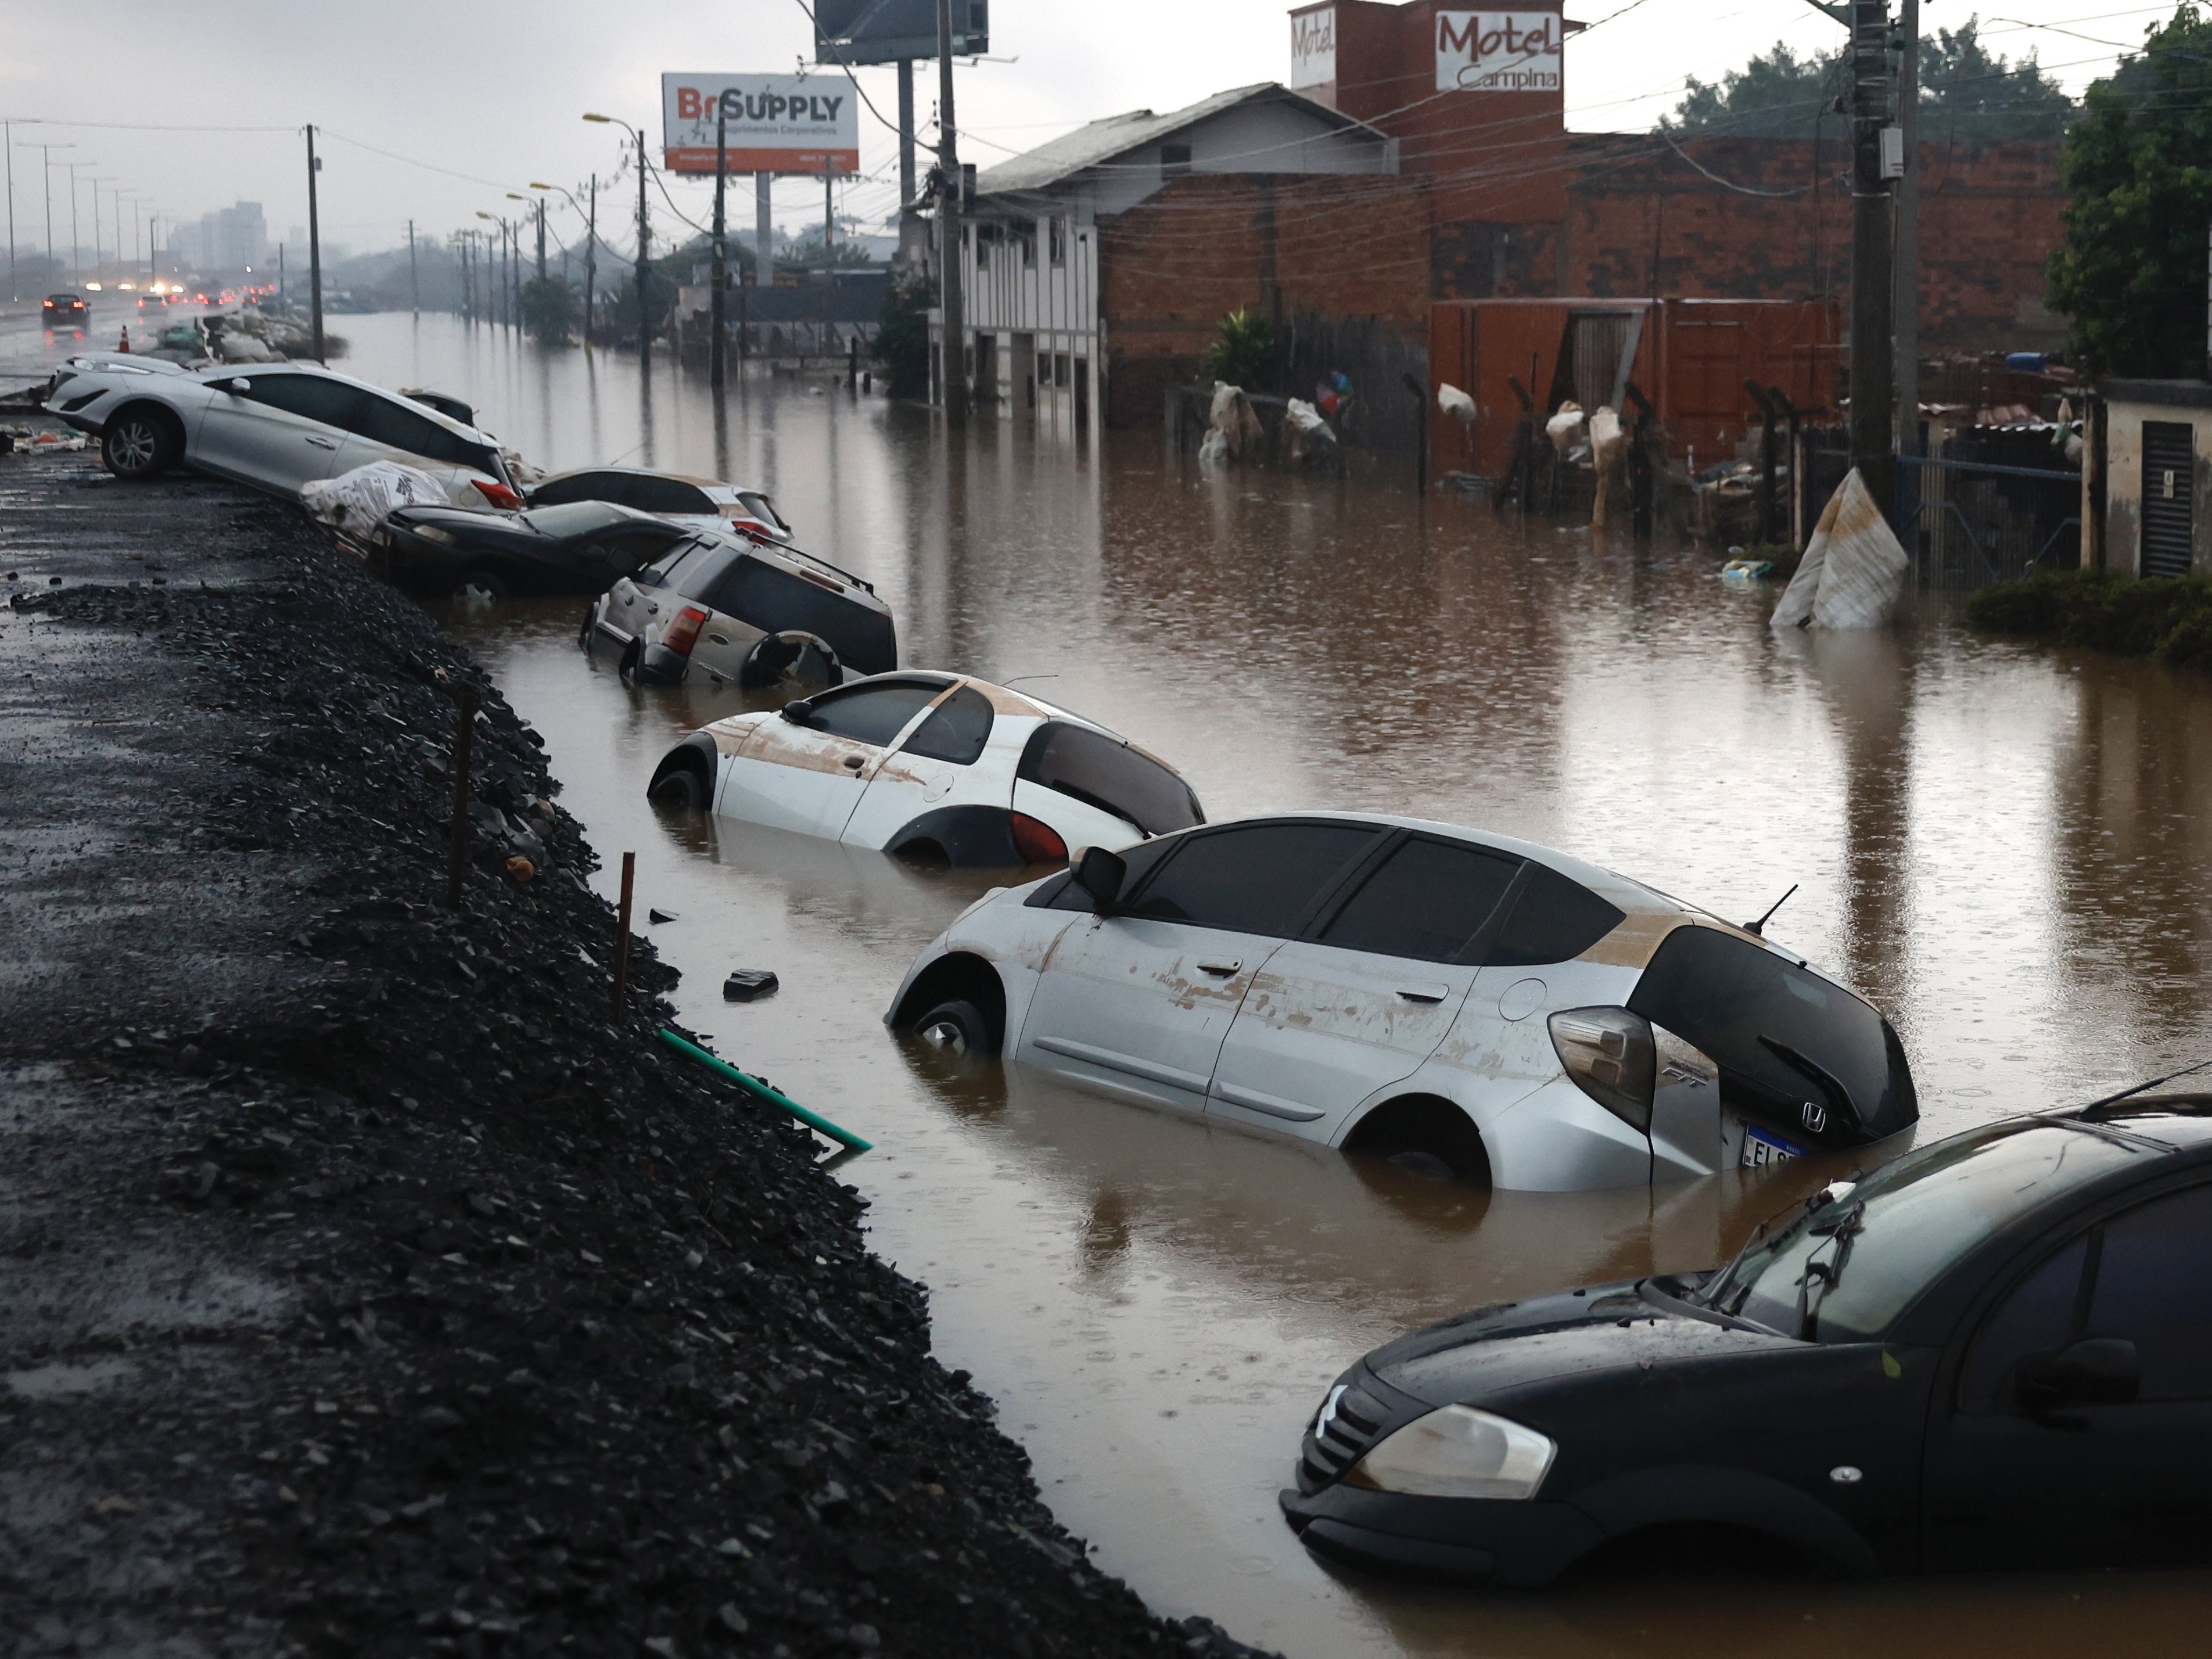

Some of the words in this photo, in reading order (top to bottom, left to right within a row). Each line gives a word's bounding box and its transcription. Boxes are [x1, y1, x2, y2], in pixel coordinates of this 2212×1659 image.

[1292, 12, 1335, 66] Motel
[1439, 16, 1559, 62] Motel
[1457, 64, 1557, 91] Campina
